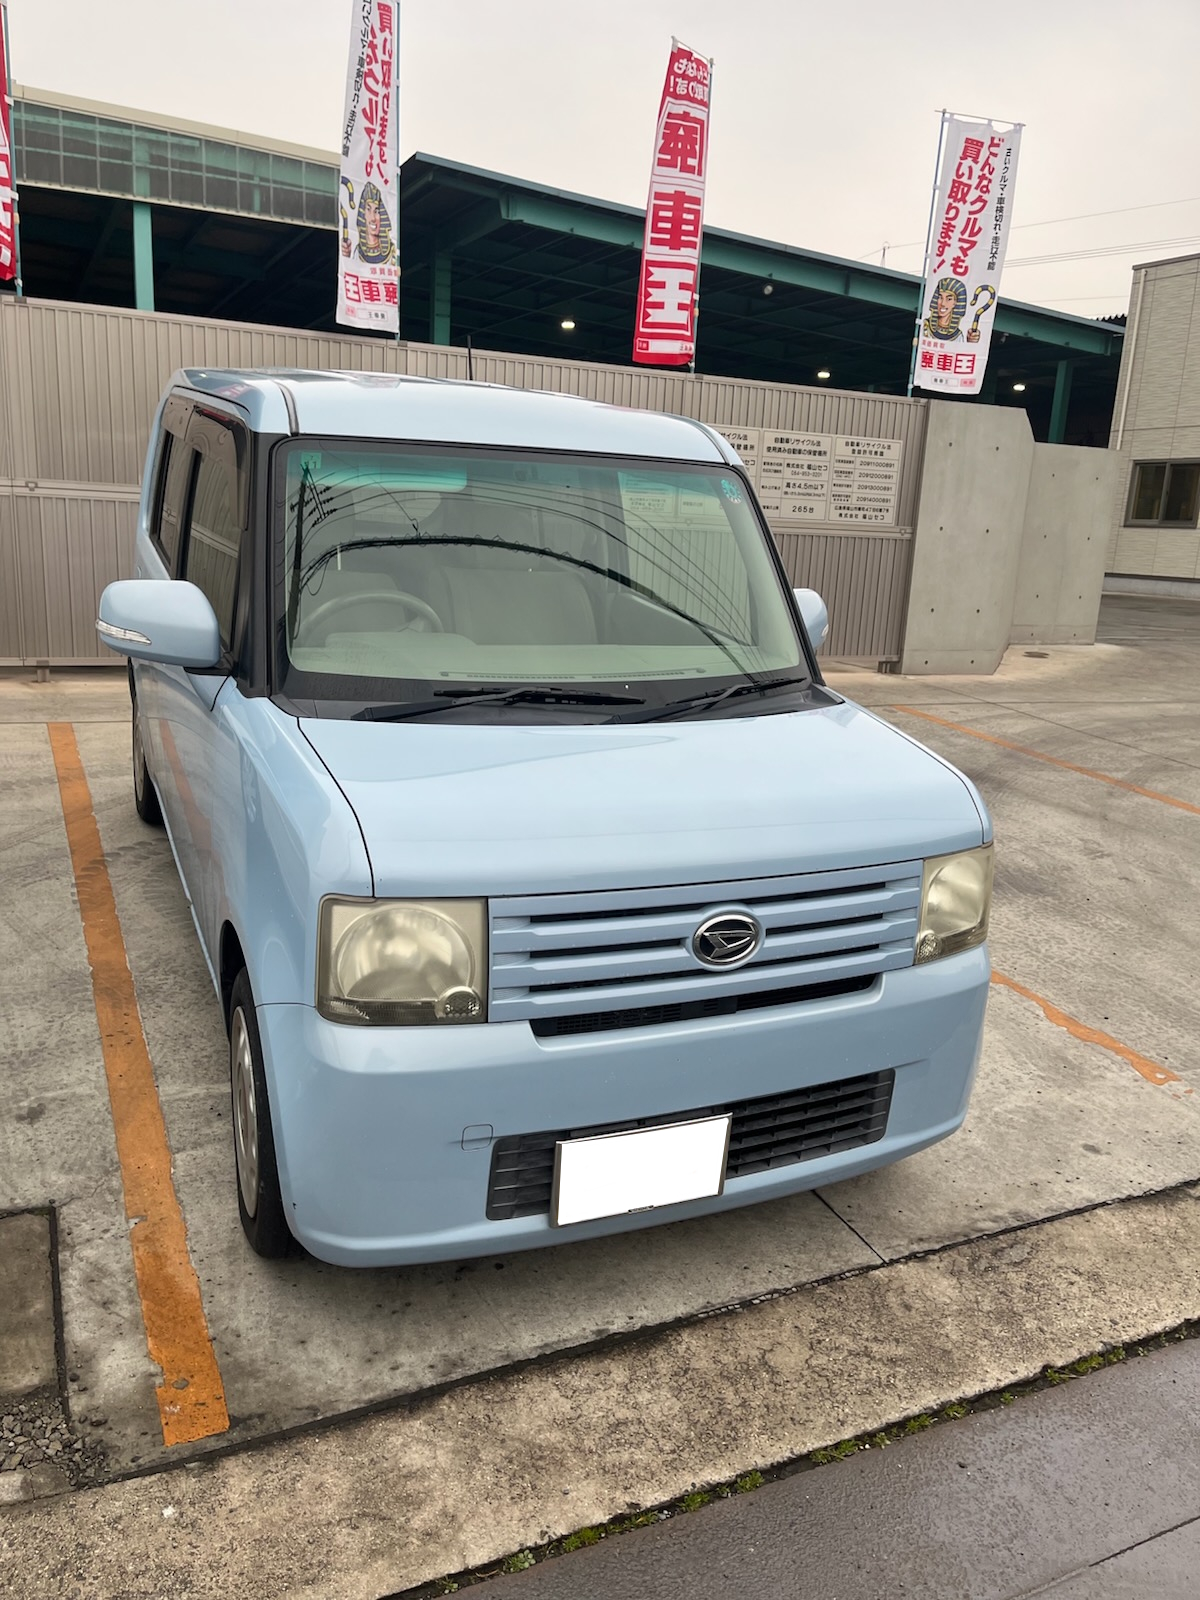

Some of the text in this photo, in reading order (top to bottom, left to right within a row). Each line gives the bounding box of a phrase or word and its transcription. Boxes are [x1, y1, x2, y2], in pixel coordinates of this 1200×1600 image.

[932, 137, 985, 275] 買い取ります!
[950, 136, 1005, 277] どんなクルマも
[921, 351, 976, 375] 廃車王
[774, 437, 821, 447] 自動車リサイクル法
[844, 441, 892, 450] 自動車リサイクル法
[792, 505, 814, 514] 265台
